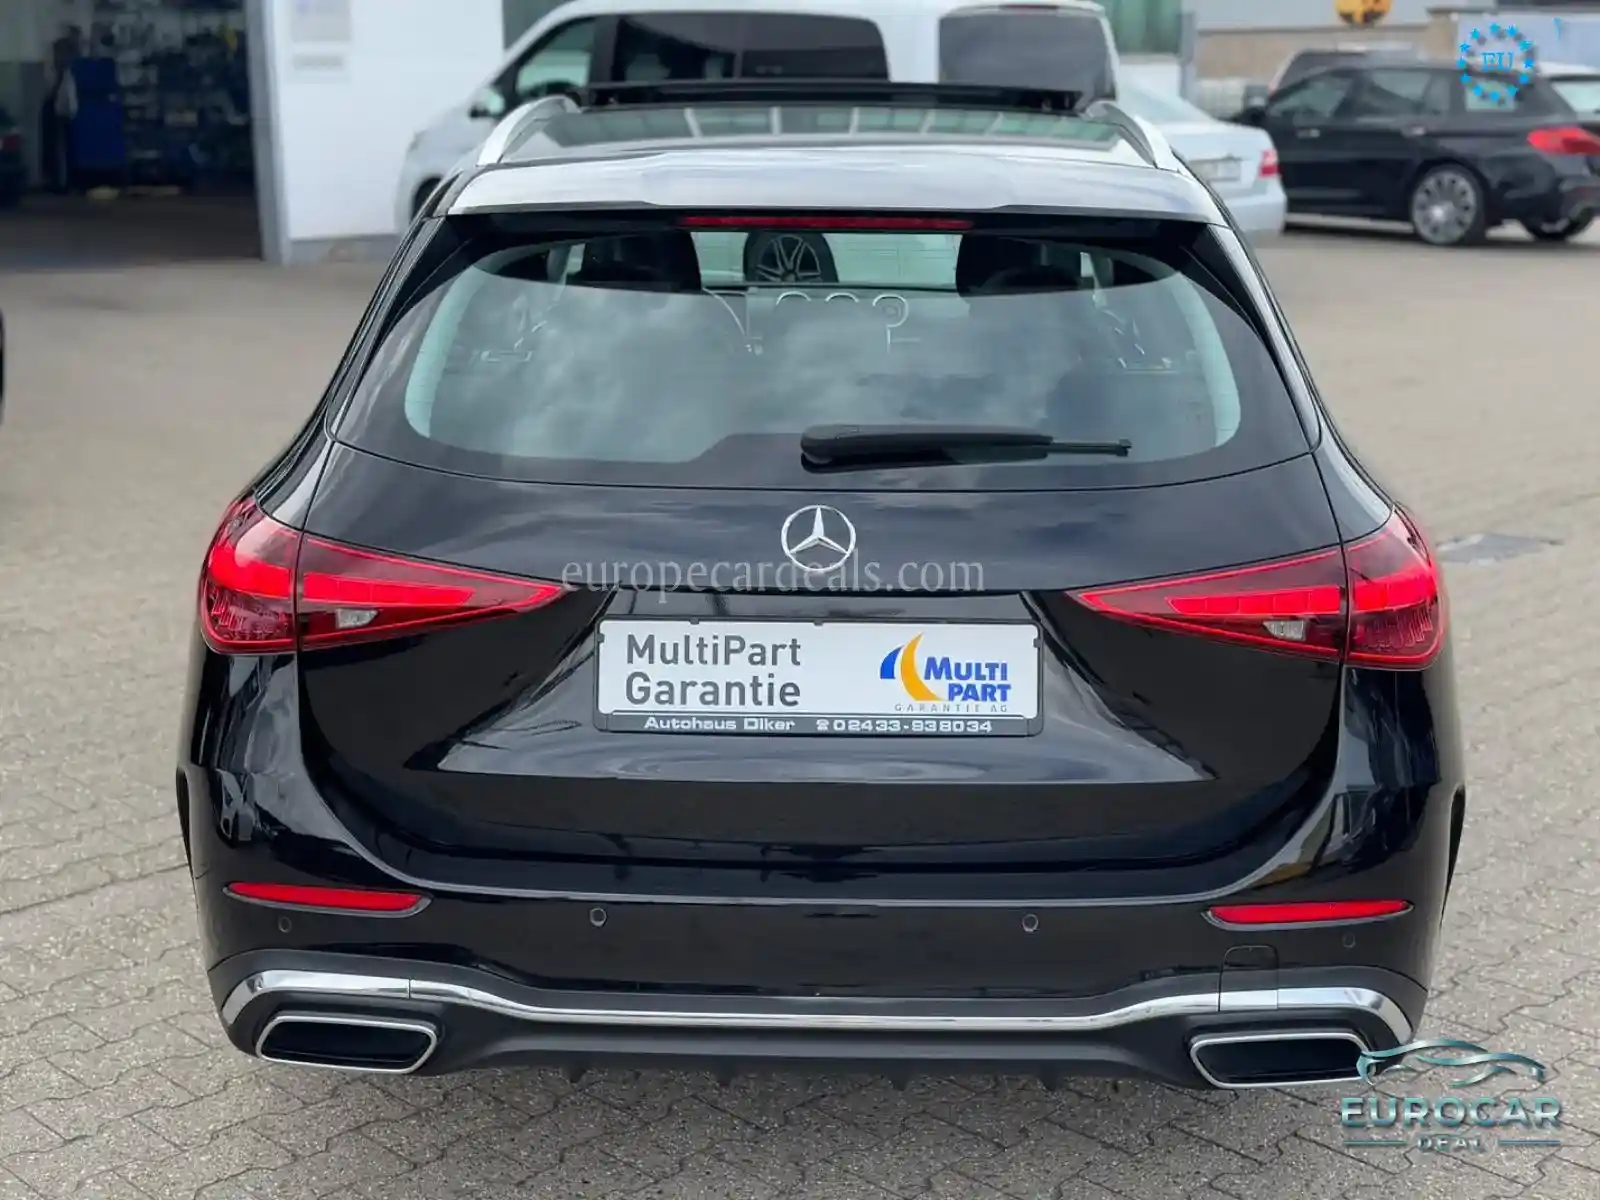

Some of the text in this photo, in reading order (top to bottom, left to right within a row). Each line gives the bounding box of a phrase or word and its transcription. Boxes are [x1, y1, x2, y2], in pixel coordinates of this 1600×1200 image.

[626, 633, 801, 667] MultiPart
[923, 656, 1008, 681] MULTI
[625, 671, 801, 707] Garantie
[947, 683, 1012, 702] PART
[894, 703, 980, 713] GARANTIE
[643, 716, 737, 730] Autohaus
